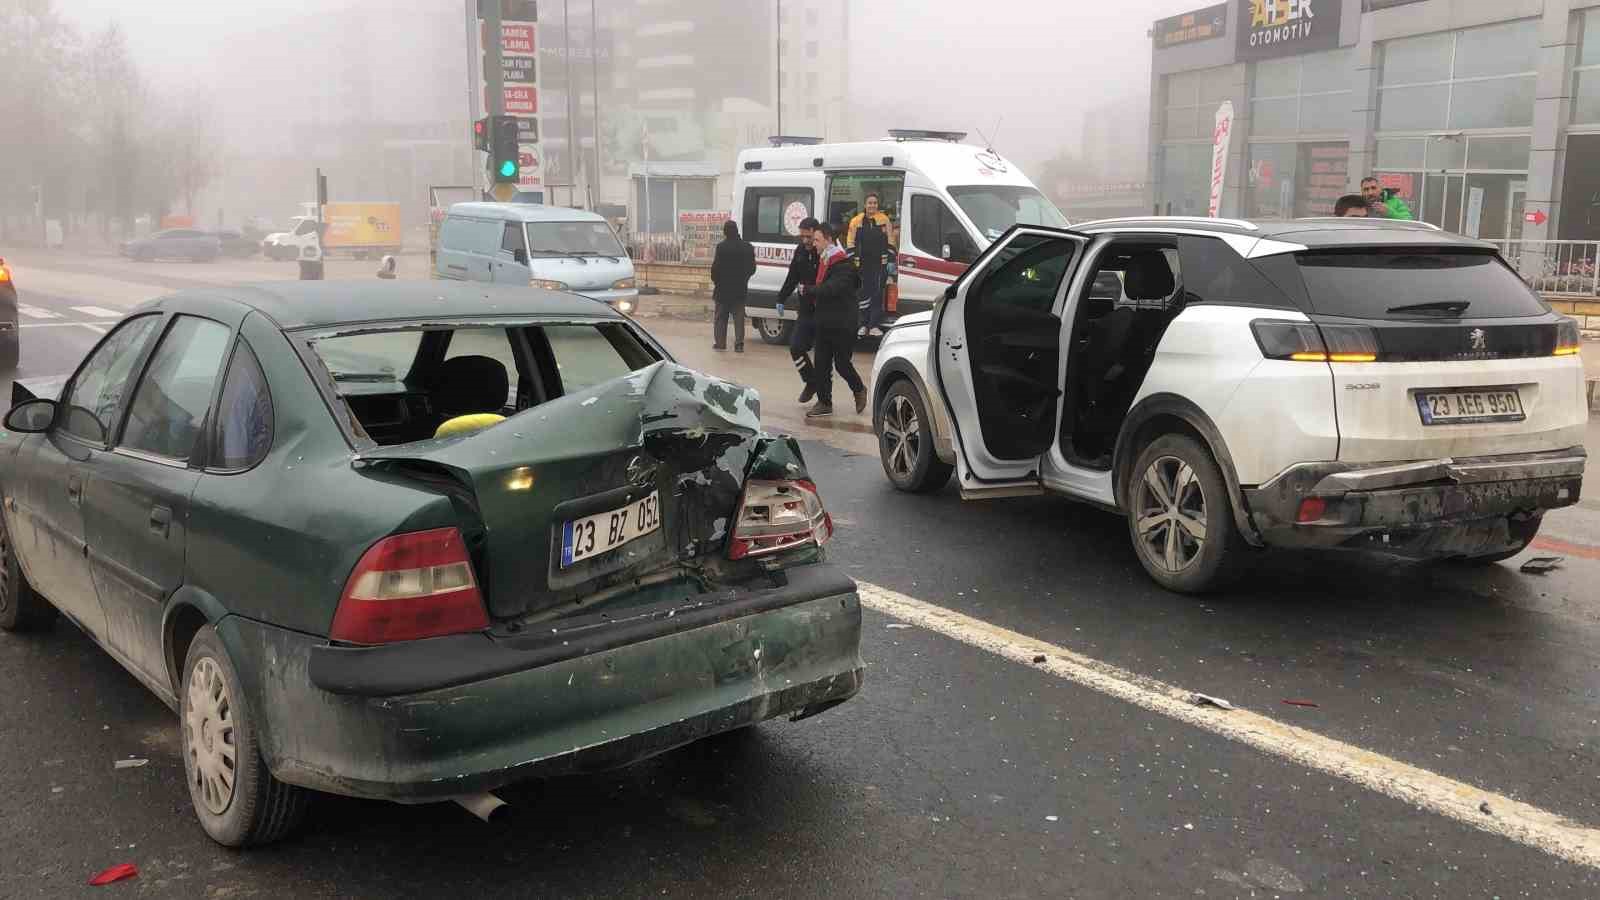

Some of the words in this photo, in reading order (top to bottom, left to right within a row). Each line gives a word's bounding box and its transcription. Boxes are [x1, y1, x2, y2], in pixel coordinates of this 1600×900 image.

[1250, 22, 1312, 47] OTOMOTİV
[1429, 394, 1450, 417] 23
[1456, 391, 1485, 415] AEG
[1489, 389, 1517, 413] 950
[575, 520, 596, 557] 23
[608, 509, 628, 546] BZ
[637, 495, 659, 532] 052
